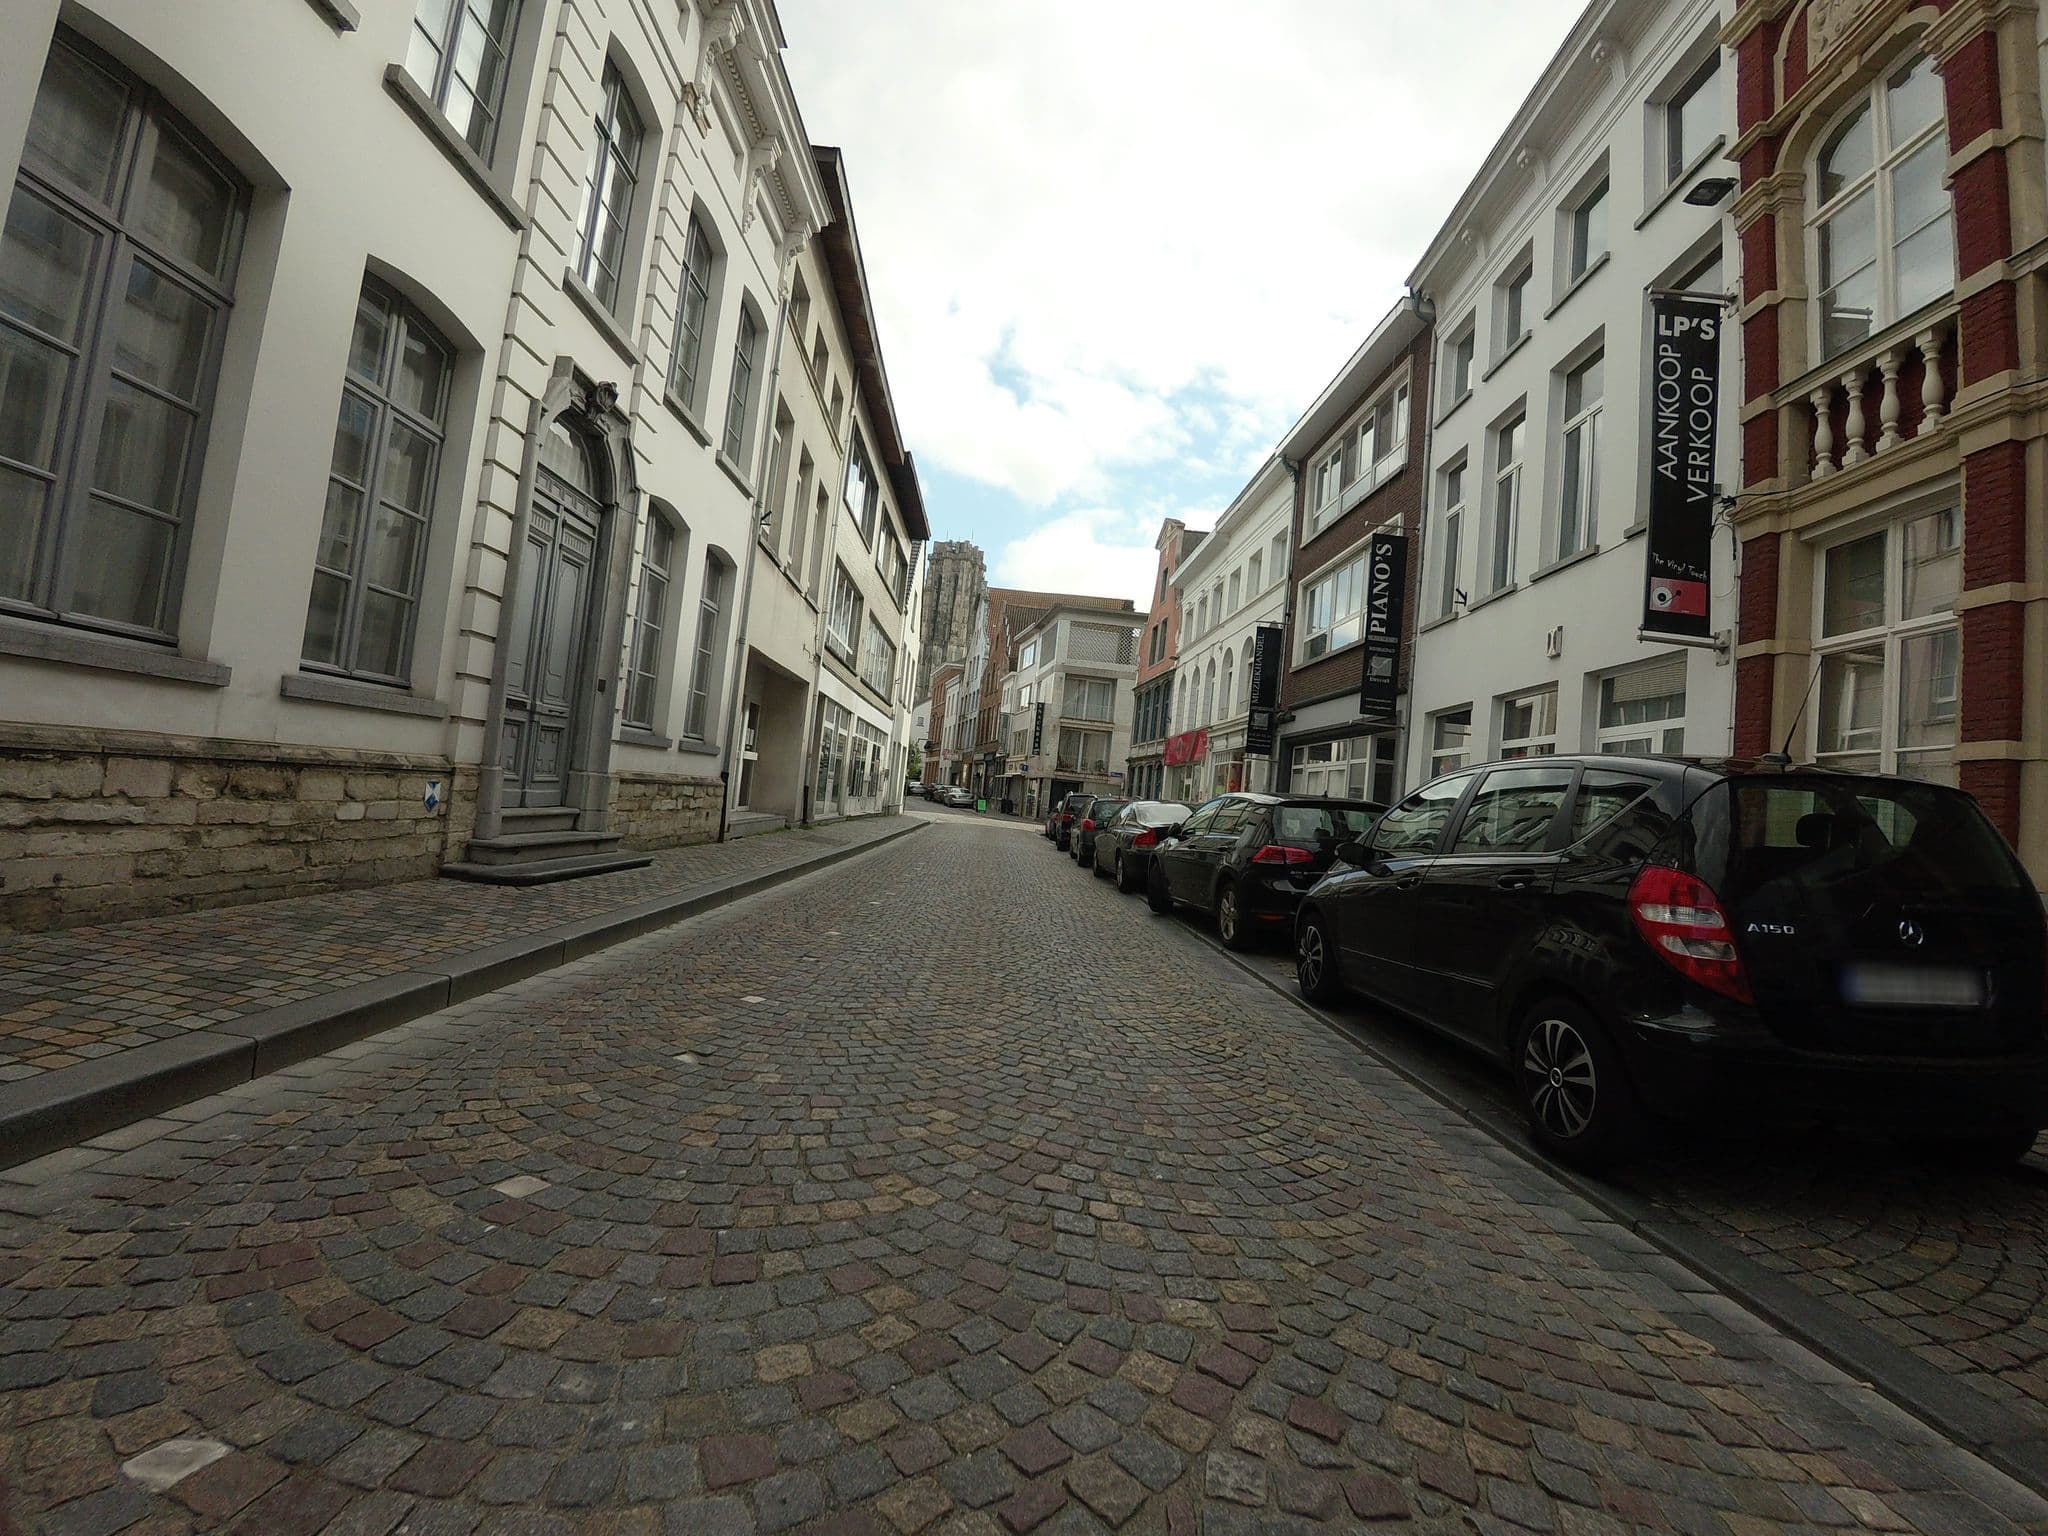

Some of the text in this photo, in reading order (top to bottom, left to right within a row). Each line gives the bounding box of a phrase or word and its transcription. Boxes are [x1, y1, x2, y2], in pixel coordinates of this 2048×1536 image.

[1658, 314, 1716, 341] LP'S
[1657, 343, 1682, 480] AANKOOP
[1686, 367, 1714, 503] VERKOOP
[1370, 543, 1393, 634] PIANO'S
[1252, 632, 1265, 704] MUZIEKHANDEL
[1747, 921, 1795, 935] A150
